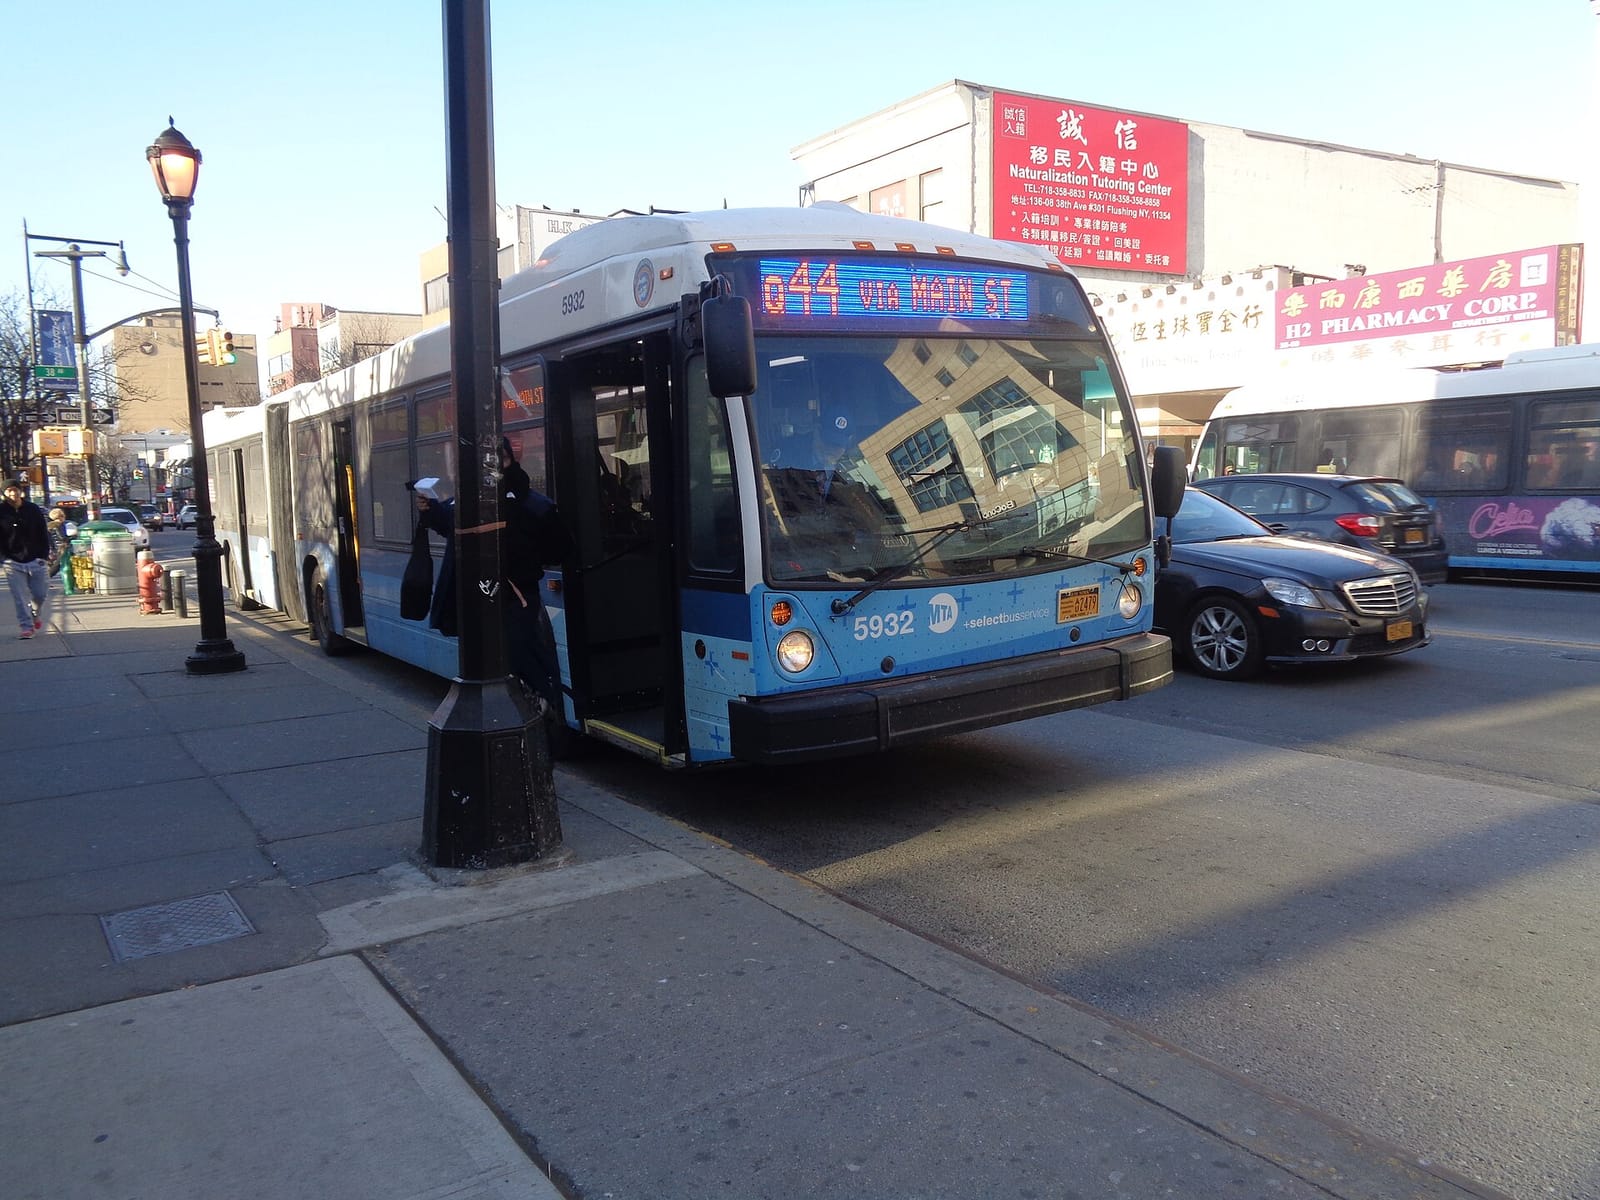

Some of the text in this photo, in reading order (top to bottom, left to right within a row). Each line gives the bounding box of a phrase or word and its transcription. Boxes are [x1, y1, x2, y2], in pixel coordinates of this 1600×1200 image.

[1056, 109, 1138, 150] 誠信
[1029, 145, 1159, 179] 移民入籍中心
[1009, 163, 1172, 196] Naturalization Tutoring Center
[1055, 199, 1072, 209] 38th
[1073, 201, 1087, 211] Ave
[1088, 203, 1105, 212] #301
[1106, 205, 1138, 219] Flushing
[1151, 210, 1172, 220] 11354
[562, 289, 585, 315] 5932
[858, 280, 899, 310] VIA
[911, 274, 973, 312] MAIN
[984, 278, 1013, 314] ST
[1285, 292, 1539, 339] H2 PHARMACY CORP.
[45, 367, 55, 377] 38
[1469, 502, 1537, 539] Celia
[853, 610, 914, 641] 5932
